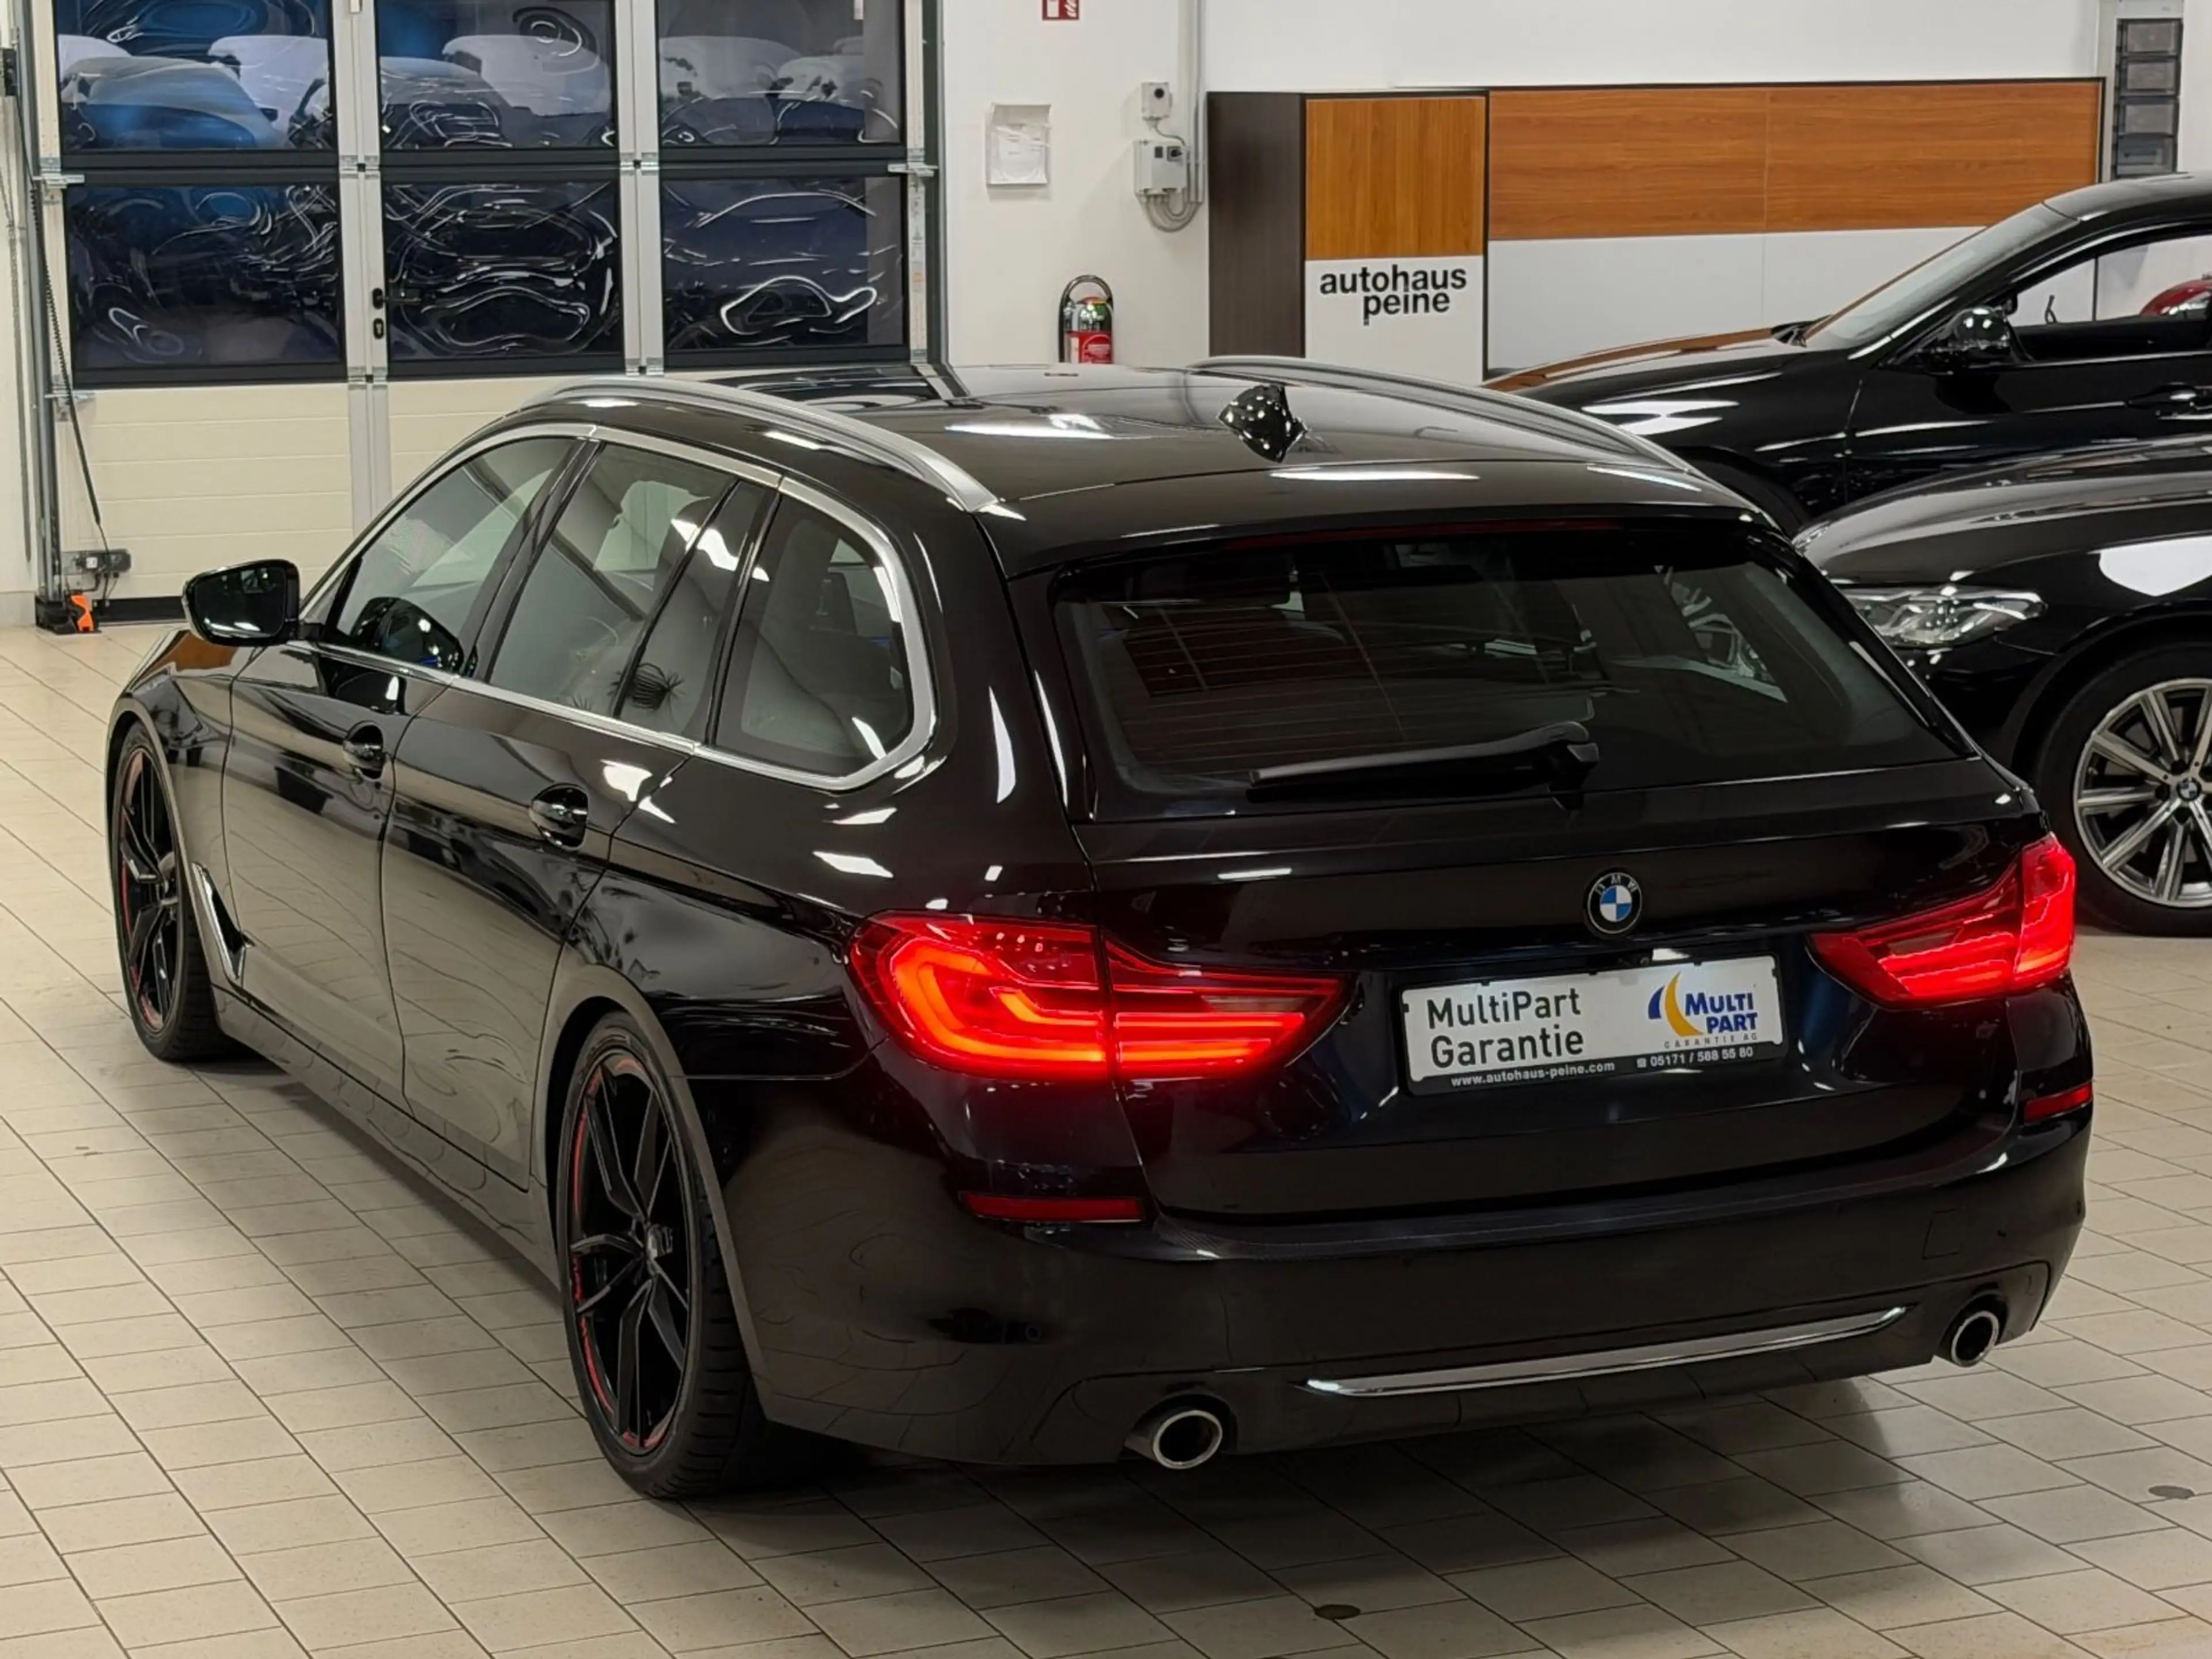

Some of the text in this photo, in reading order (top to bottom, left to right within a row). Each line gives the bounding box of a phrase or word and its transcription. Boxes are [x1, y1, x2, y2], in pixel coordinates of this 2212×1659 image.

[1320, 264, 1467, 294] autohaus
[1363, 292, 1450, 326] peine
[1427, 988, 1581, 1029] MultiPart
[1685, 993, 1753, 1016] MULTI
[1706, 1013, 1758, 1034] PART
[1431, 1024, 1584, 1069] Garantie
[1451, 1061, 1615, 1086] www.autohaus-peine.com
[1650, 1054, 1685, 1067] 05171
